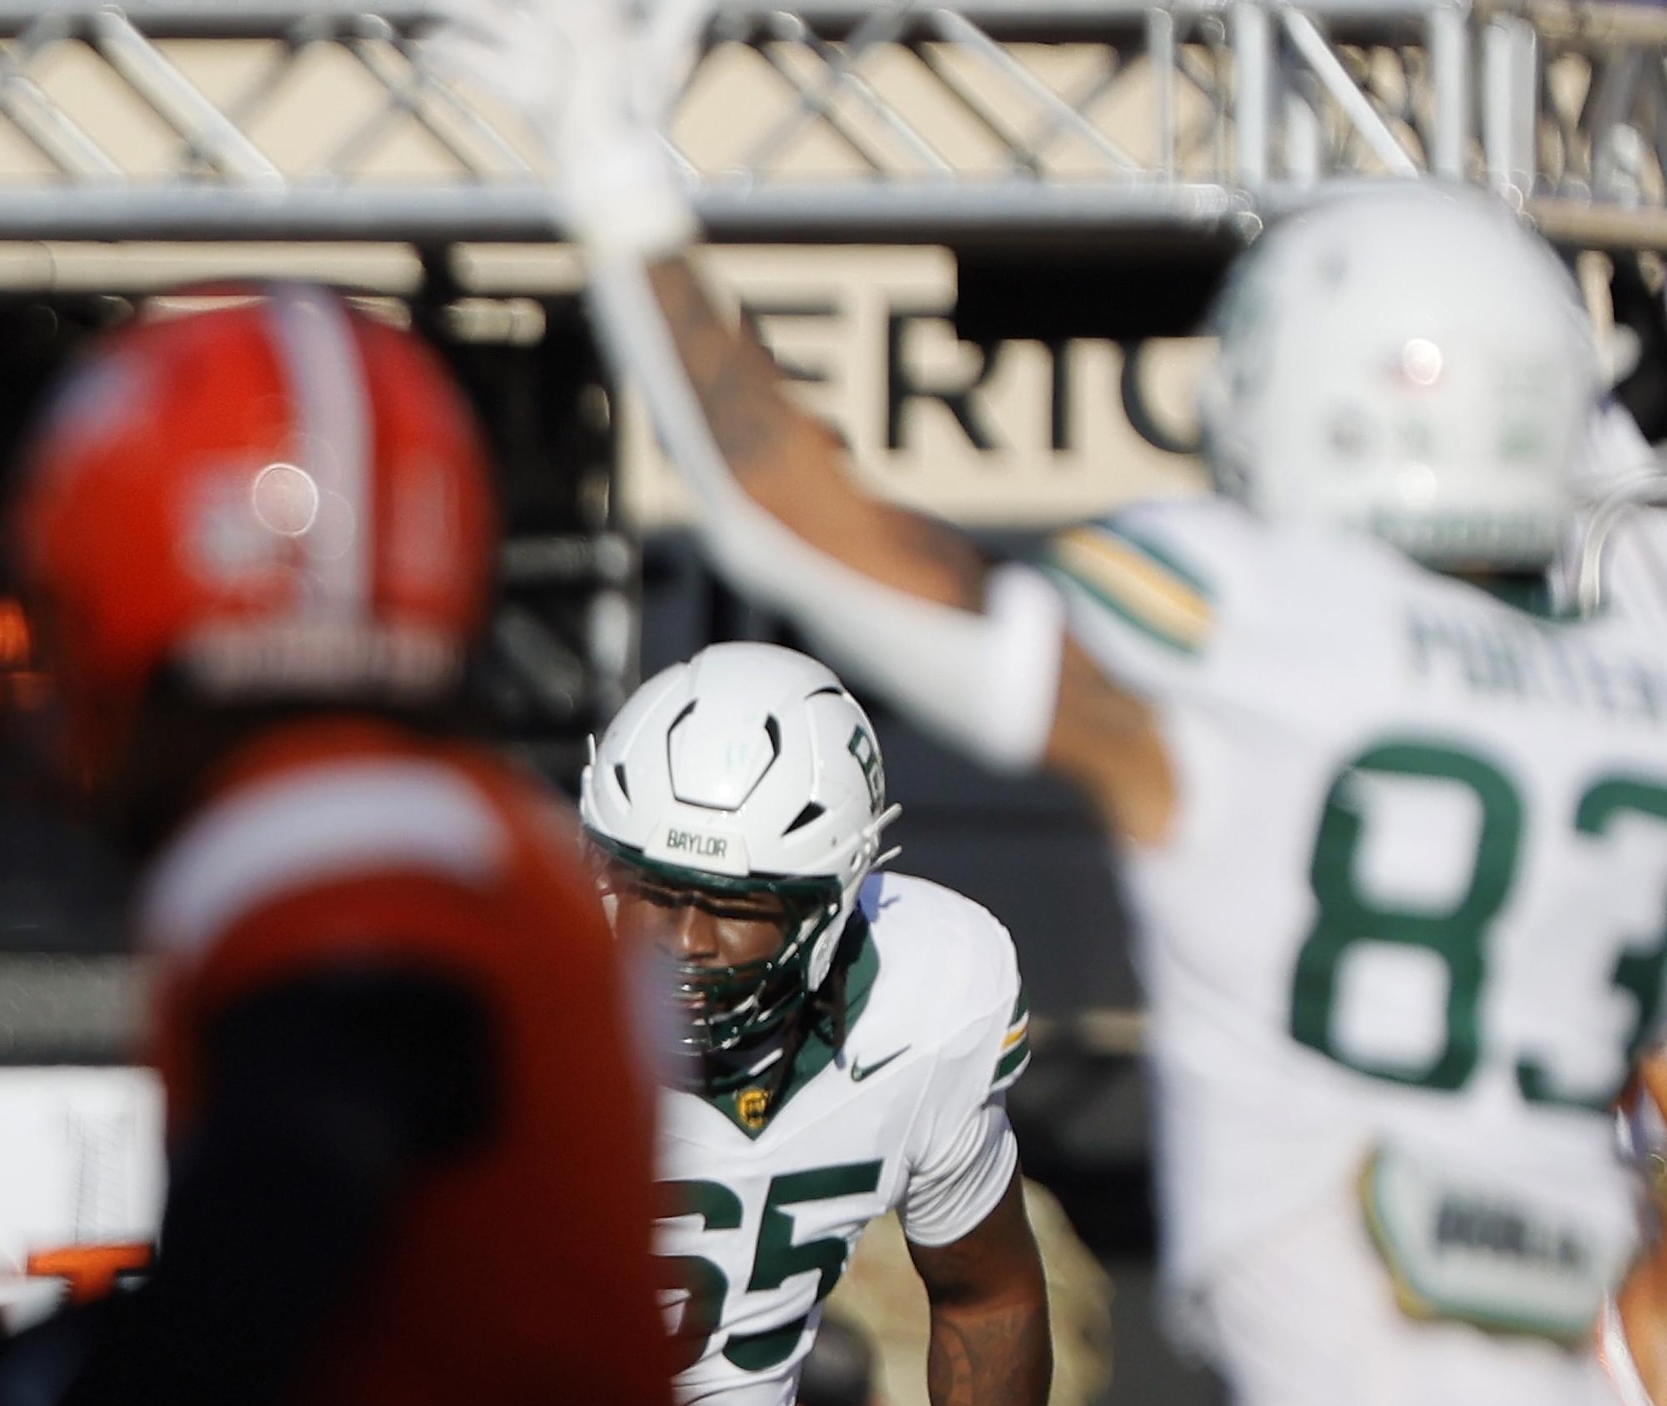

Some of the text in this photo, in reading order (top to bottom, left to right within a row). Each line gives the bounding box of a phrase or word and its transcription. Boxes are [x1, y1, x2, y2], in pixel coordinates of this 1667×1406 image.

[668, 829, 728, 858] BAYLOR
[1289, 735, 1667, 1115] 83
[647, 1158, 885, 1378] 65
